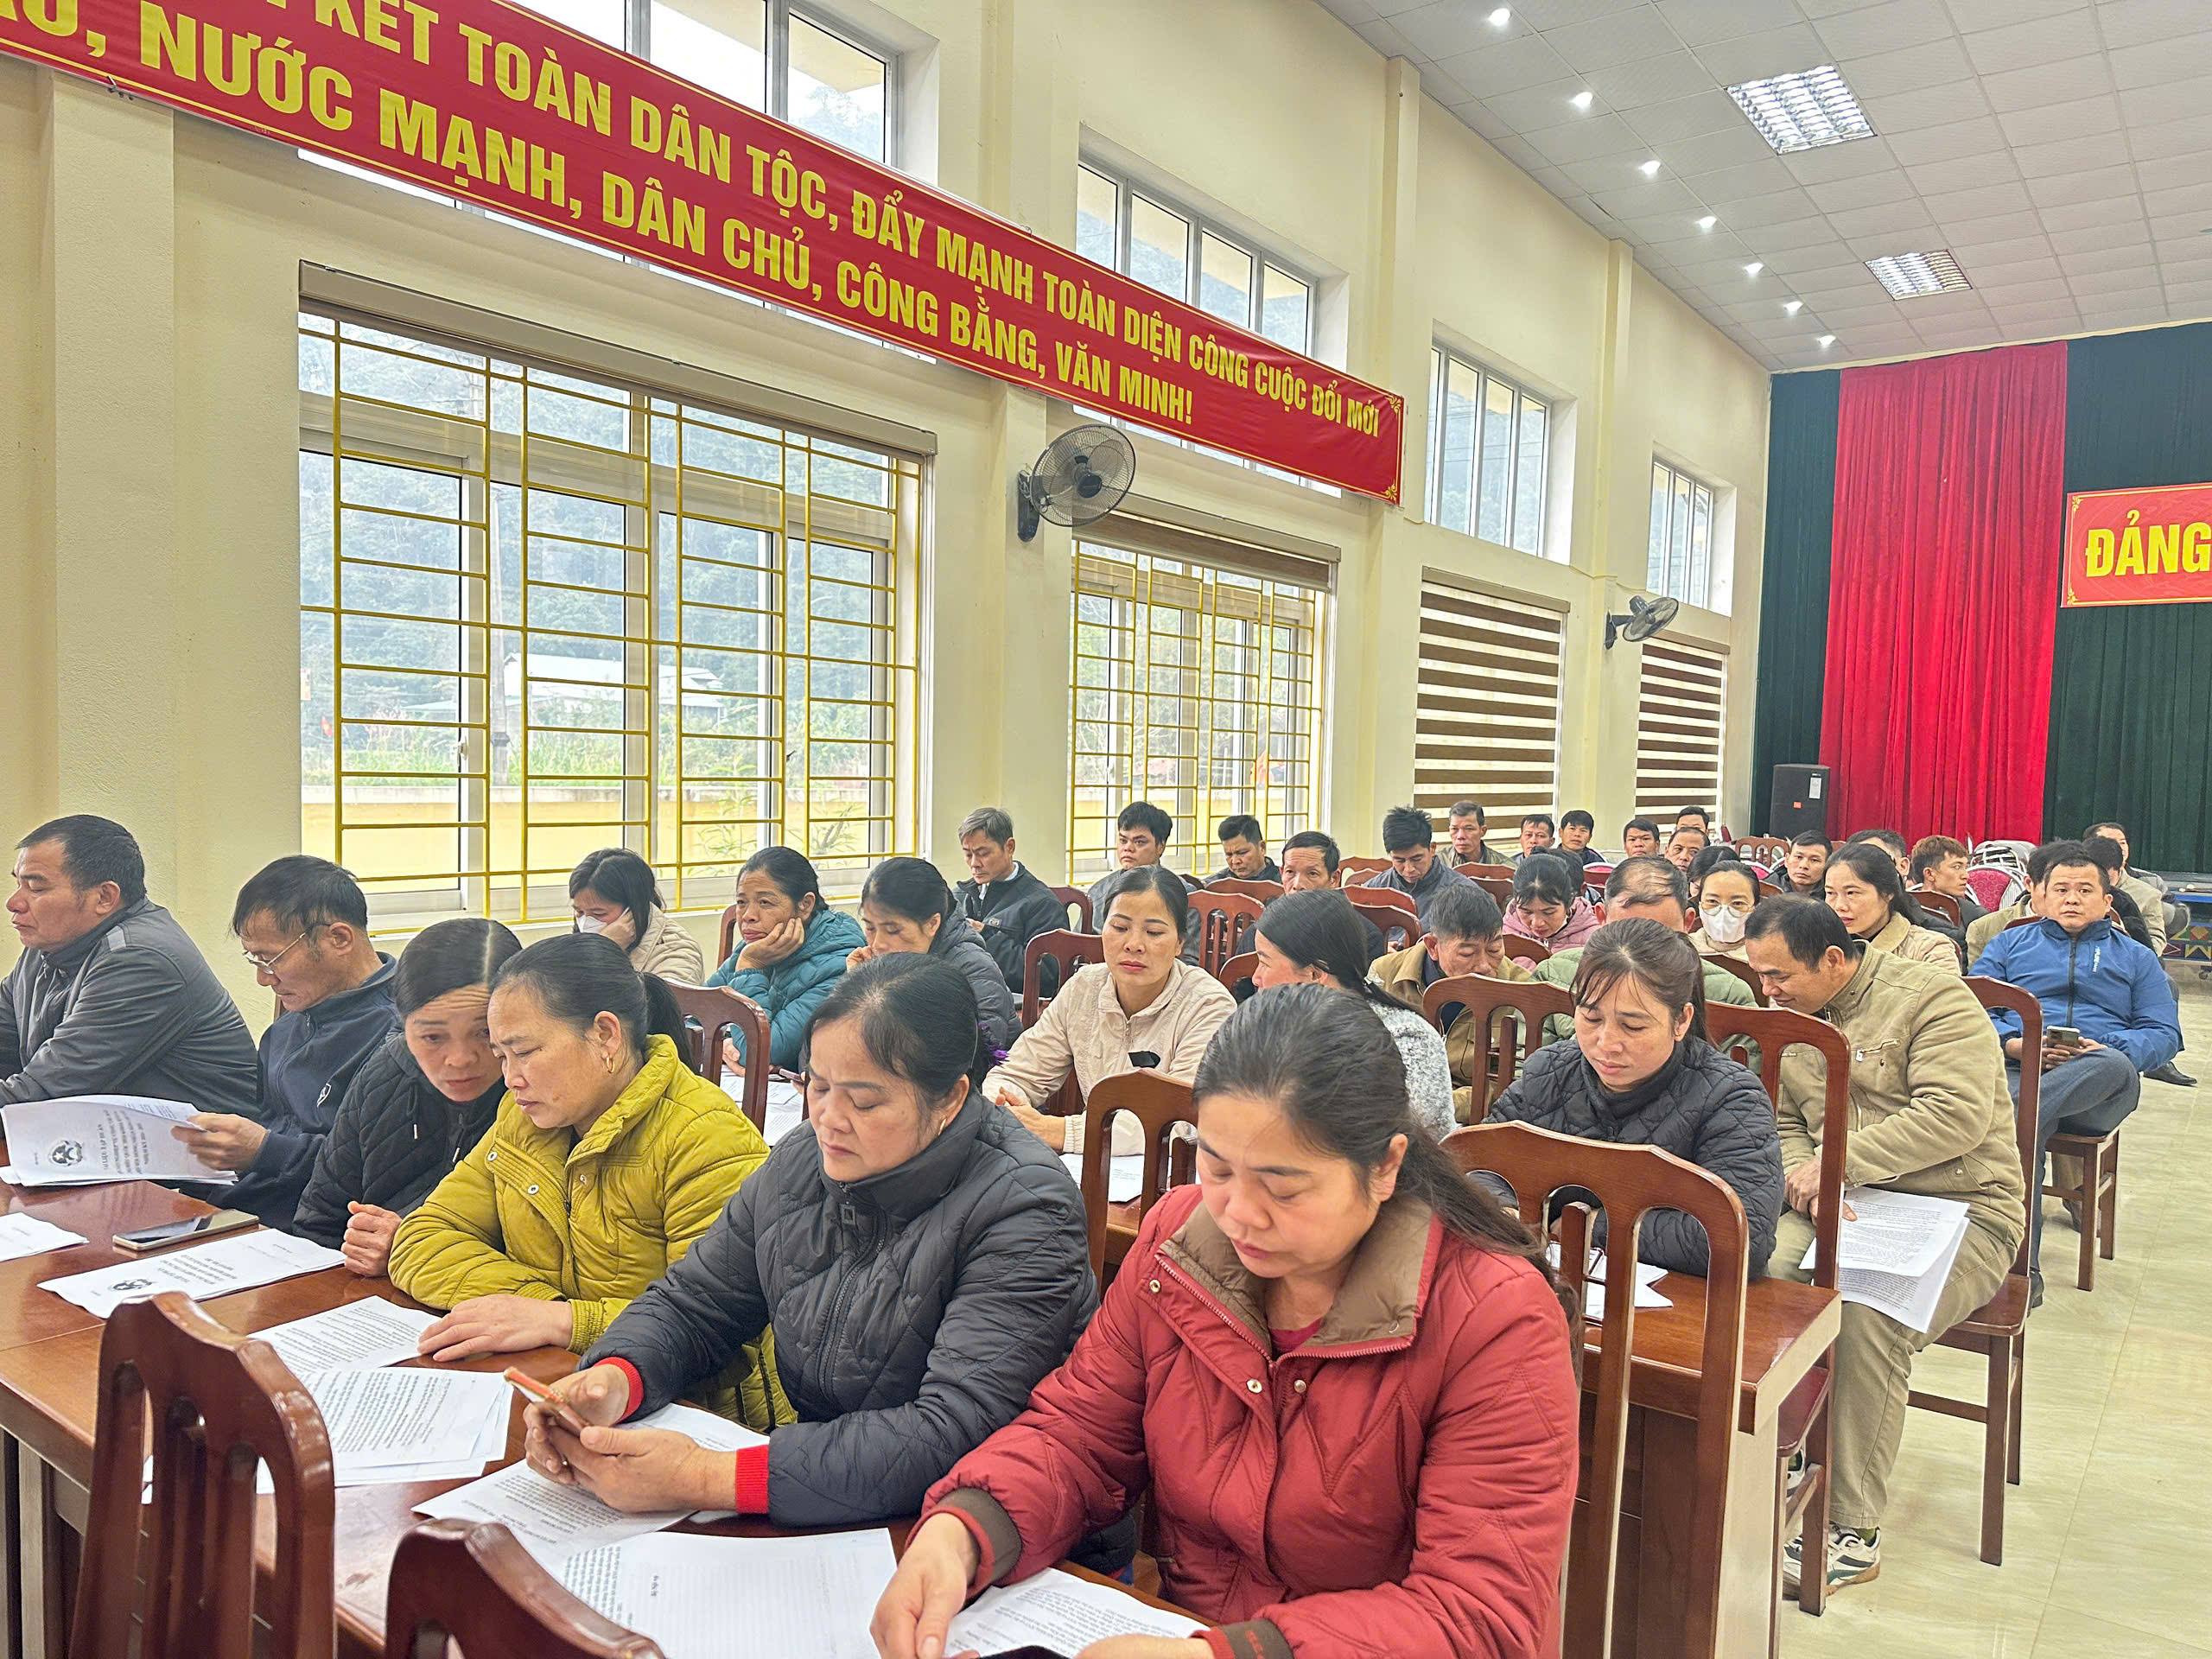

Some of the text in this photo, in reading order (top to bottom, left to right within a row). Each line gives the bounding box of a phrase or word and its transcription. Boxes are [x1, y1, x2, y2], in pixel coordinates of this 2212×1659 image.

[140, 0, 353, 131] NƯỚC
[379, 88, 582, 220] MẠNH,
[602, 171, 706, 257] DÂN
[722, 218, 823, 302] CHỦ,
[836, 261, 939, 338] CÔNG
[950, 285, 1046, 380] BẰNG,
[1055, 340, 1111, 397] VĂN
[1119, 365, 1194, 425] MINH!
[459, 23, 611, 137] TOÀN
[631, 96, 731, 184] DÂN
[747, 145, 839, 232] TỘC,
[851, 189, 925, 258] ĐẨY
[936, 226, 1033, 304] MẠNH
[1042, 271, 1116, 337] TOÀN
[1123, 308, 1182, 364] DIỆN
[1188, 333, 1249, 389] CÔNG
[1255, 361, 1307, 412] CUỘC
[1312, 379, 1342, 424] ĐỔI
[1346, 399, 1380, 437] MỚI
[2084, 509, 2212, 578] ĐẢNG
